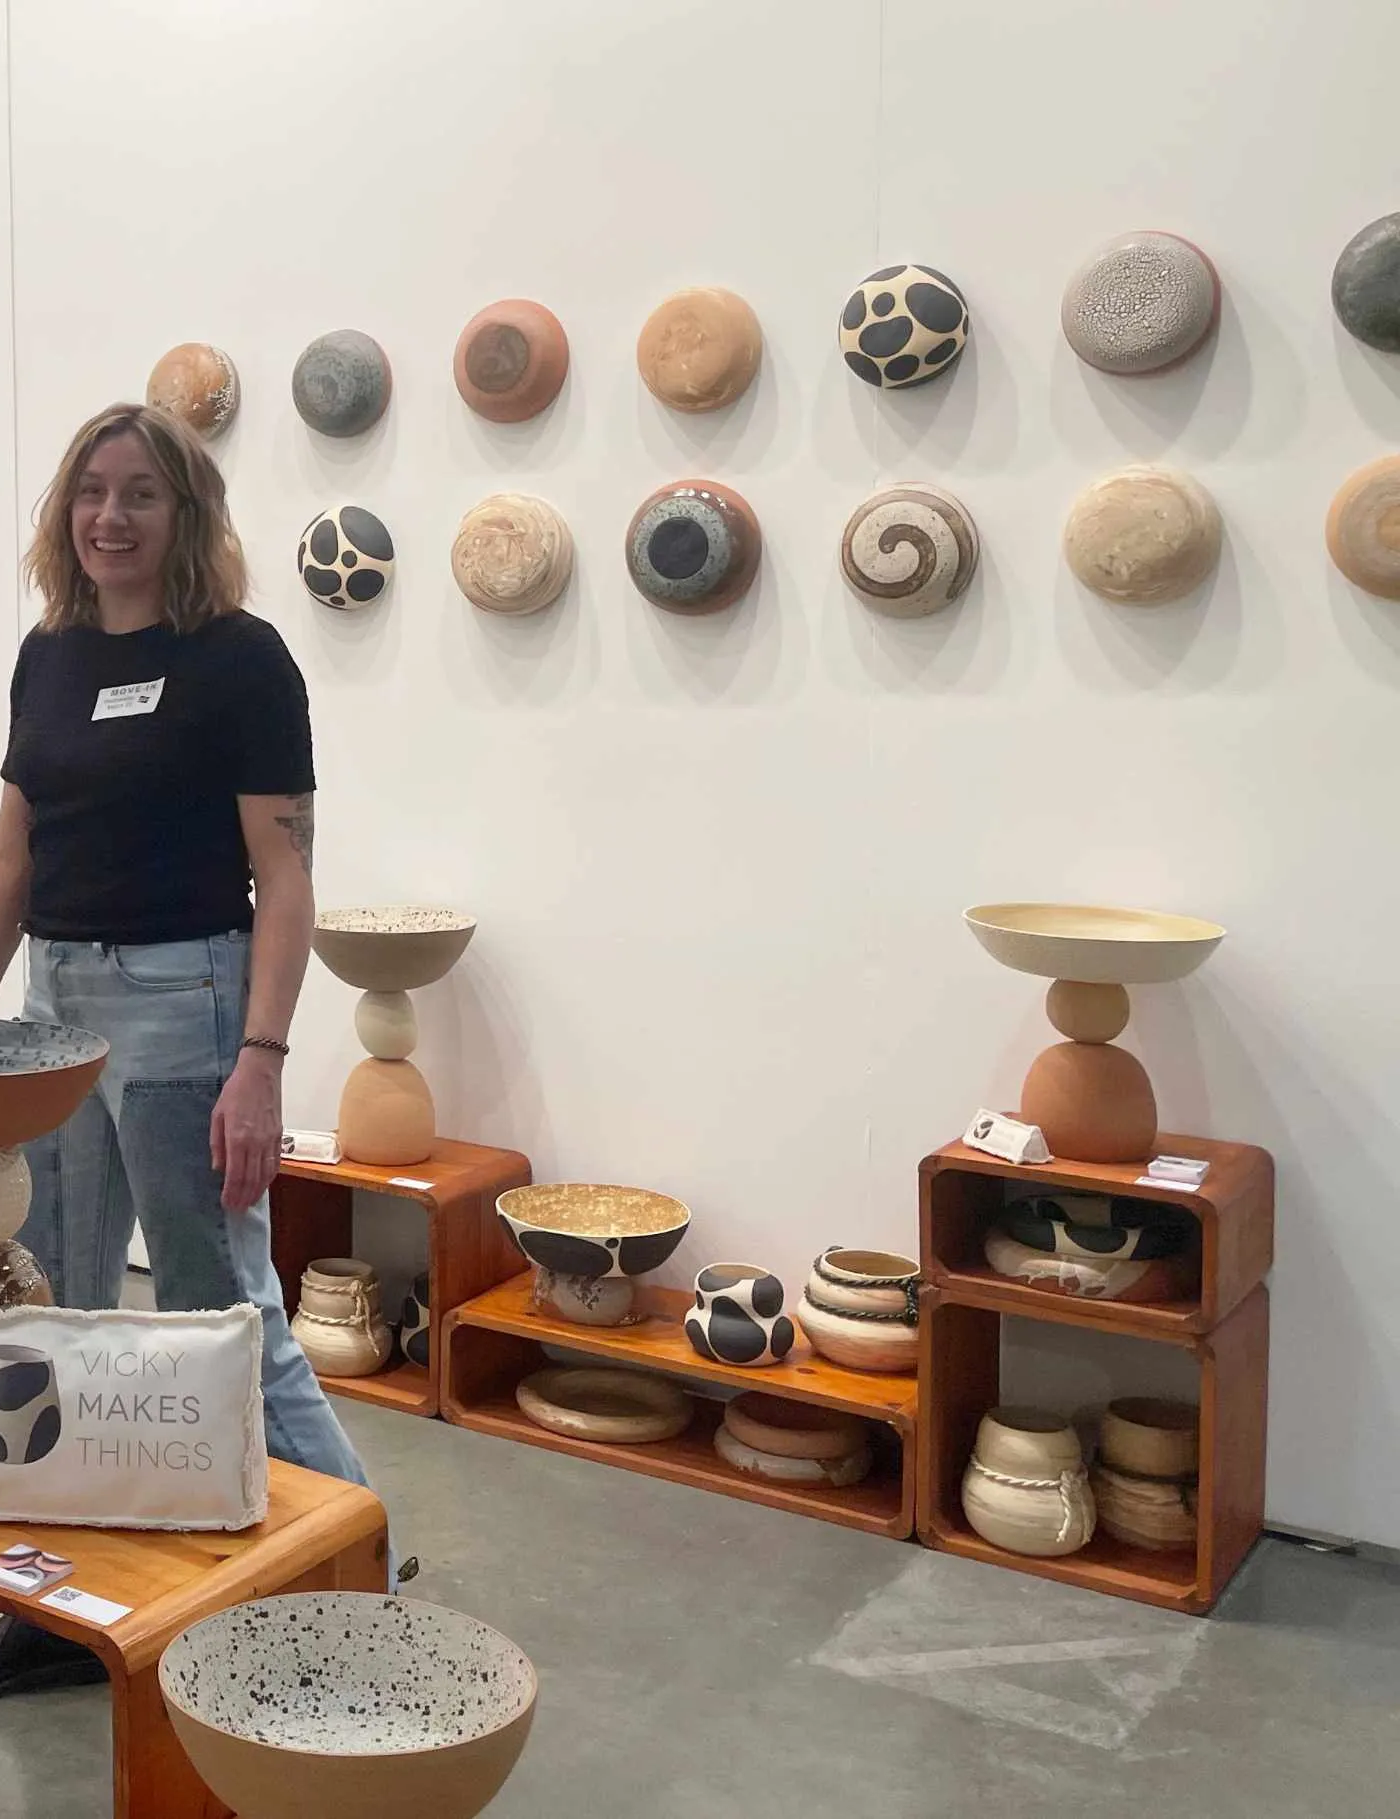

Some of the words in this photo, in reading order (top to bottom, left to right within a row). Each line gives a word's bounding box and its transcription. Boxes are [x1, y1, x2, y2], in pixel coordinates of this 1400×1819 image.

[80, 1351, 185, 1378] VICKY
[78, 1392, 200, 1424] MAKES
[75, 1437, 213, 1471] THINGS
